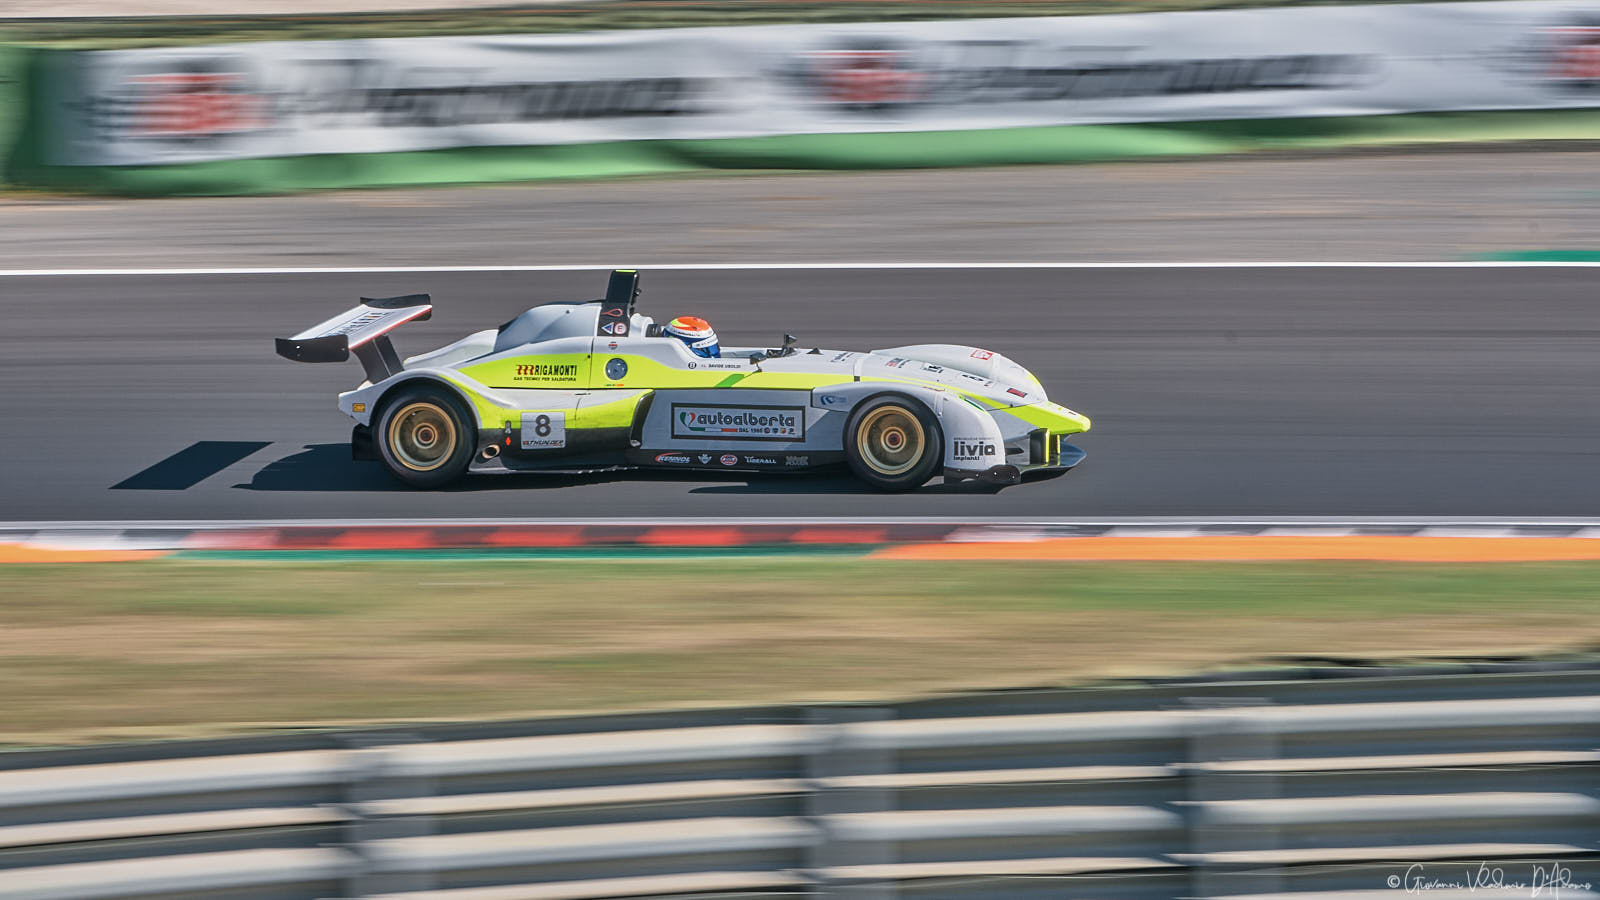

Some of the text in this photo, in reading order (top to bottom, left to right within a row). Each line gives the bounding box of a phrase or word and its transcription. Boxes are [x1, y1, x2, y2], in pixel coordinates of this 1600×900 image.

[535, 364, 577, 376] RIGAMONTI
[535, 414, 552, 437] 8
[697, 412, 795, 427] autoalberta
[954, 441, 996, 456] livia
